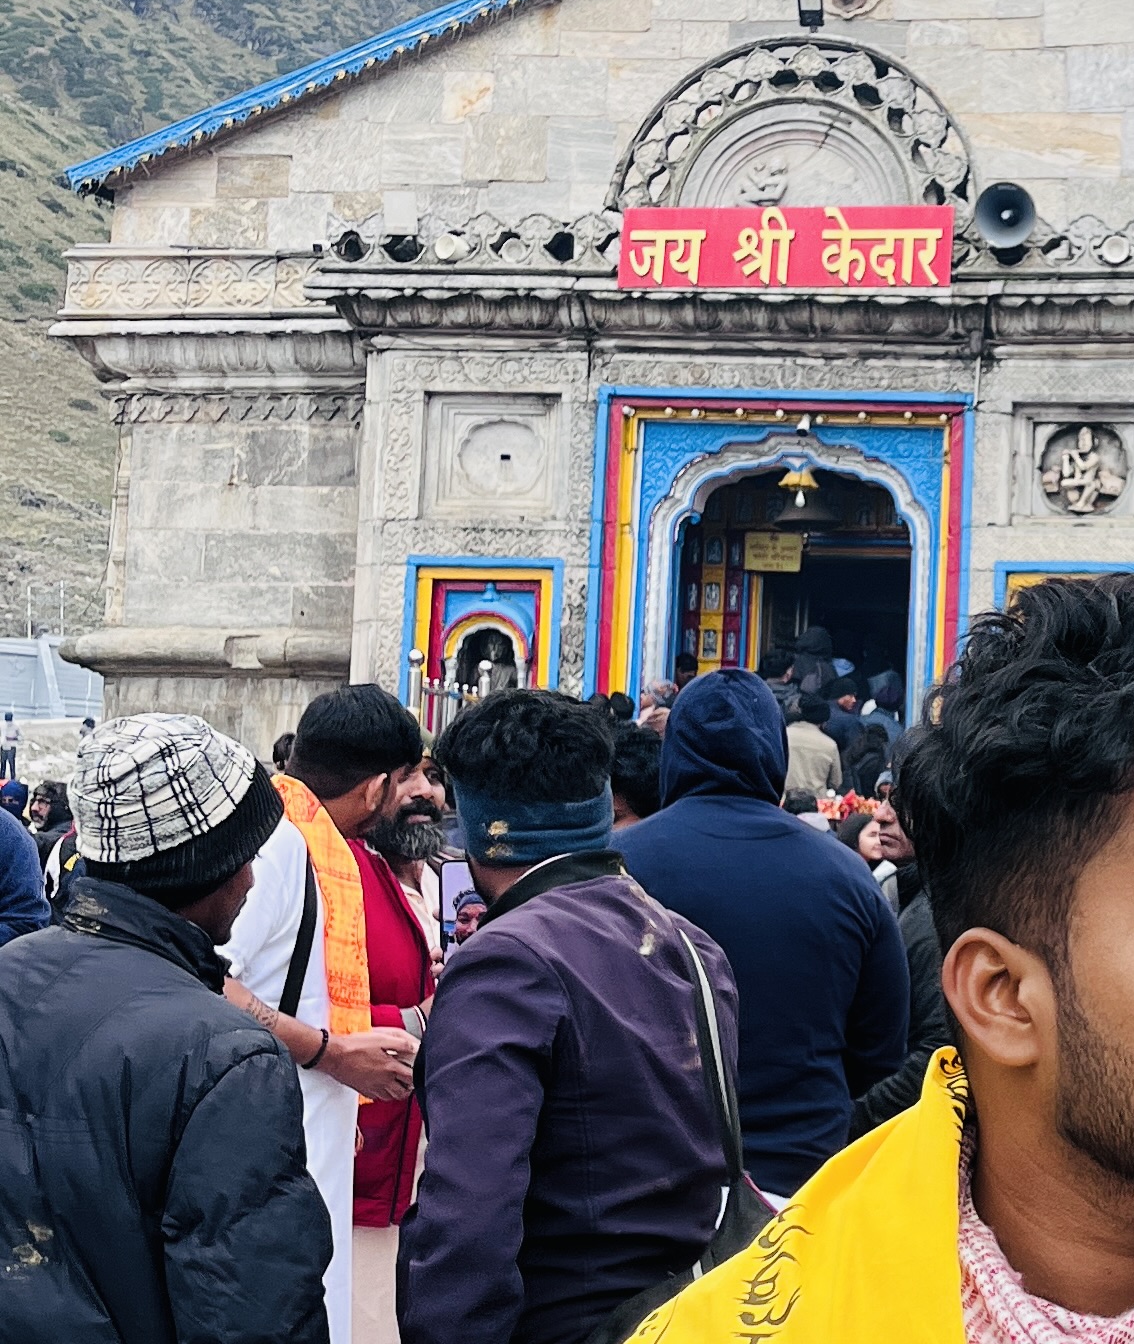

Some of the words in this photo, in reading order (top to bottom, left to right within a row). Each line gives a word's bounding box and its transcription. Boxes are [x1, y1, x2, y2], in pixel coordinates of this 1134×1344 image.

[629, 228, 707, 285] जय
[733, 206, 796, 285] श्री
[821, 206, 943, 286] केदार
